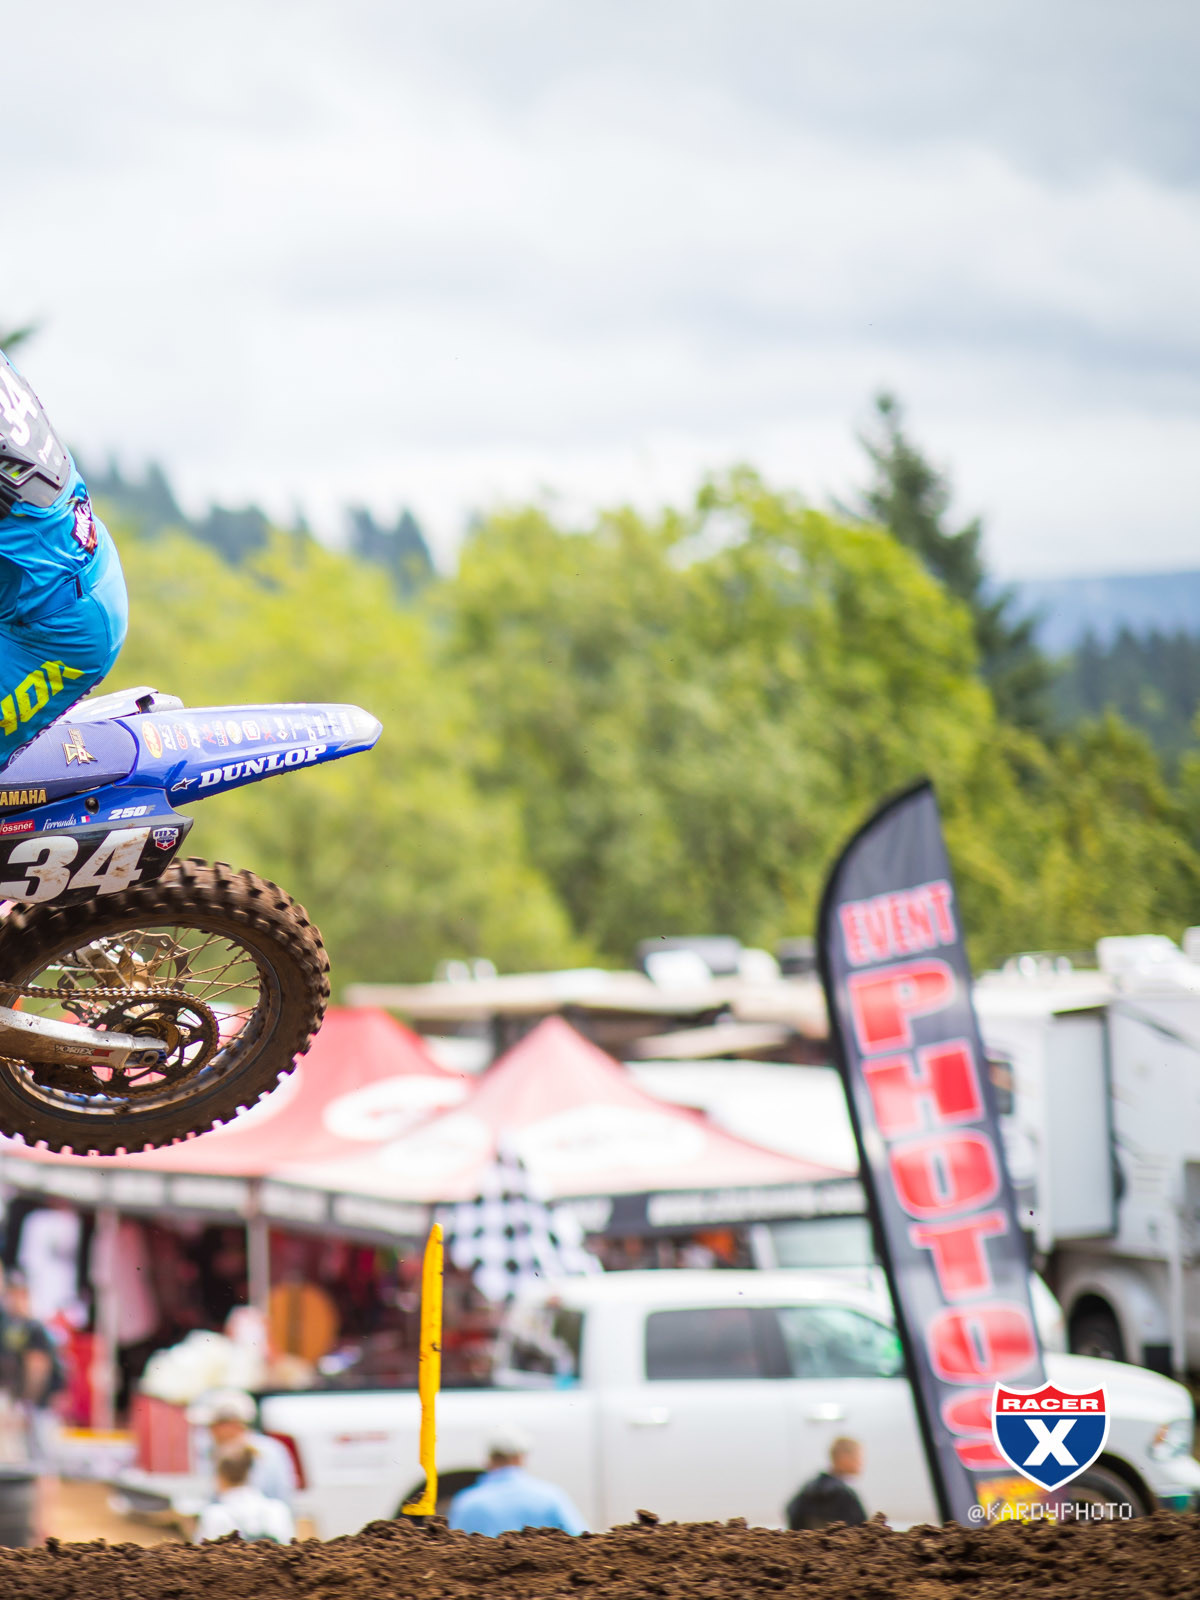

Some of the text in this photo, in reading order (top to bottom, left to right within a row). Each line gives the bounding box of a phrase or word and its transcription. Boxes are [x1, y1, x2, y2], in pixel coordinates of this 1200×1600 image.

[199, 744, 328, 789] DUNLOP
[42, 814, 77, 831] Ferrandis
[840, 880, 956, 967] EVENT
